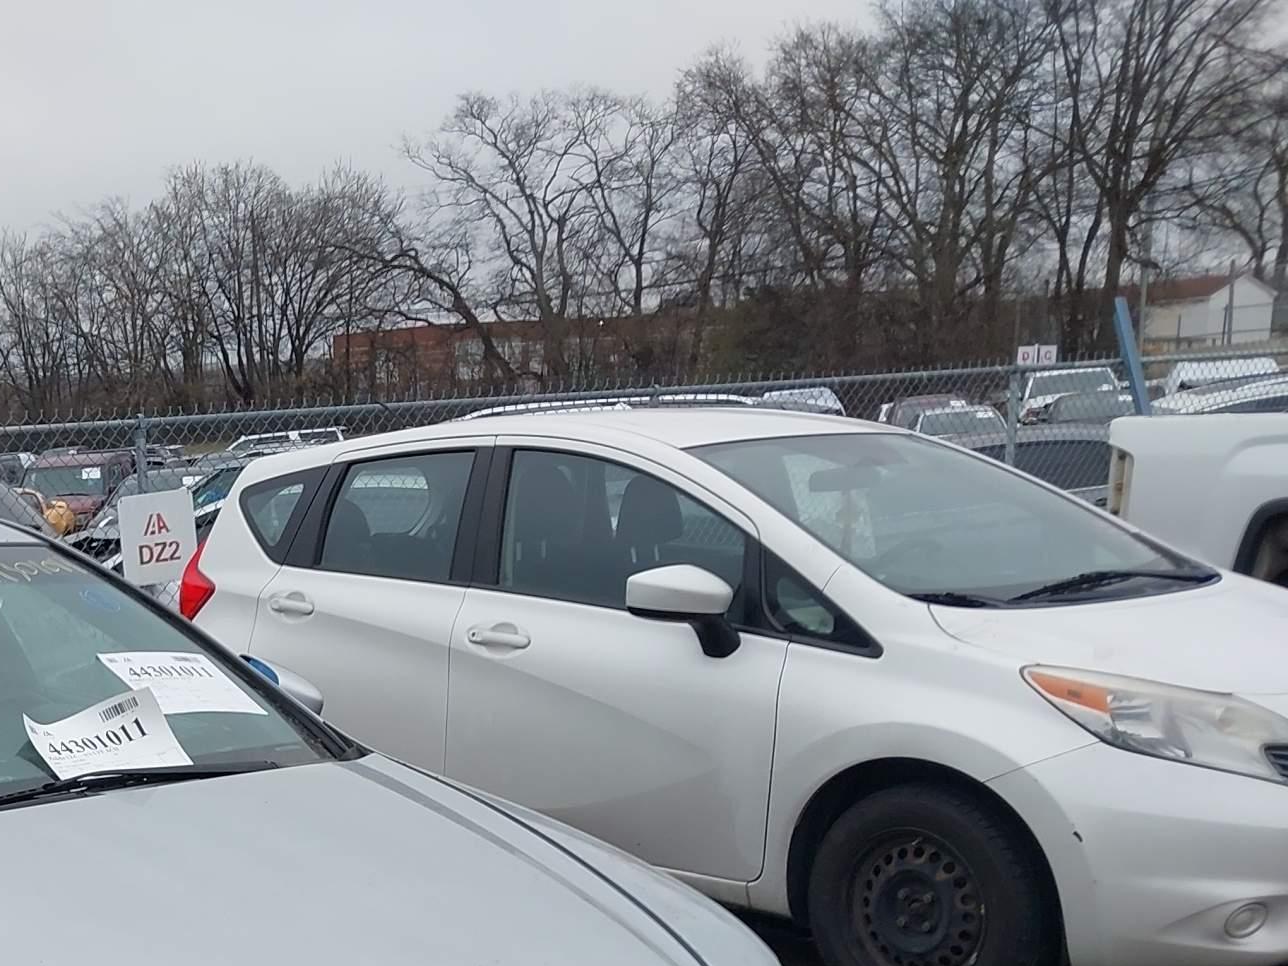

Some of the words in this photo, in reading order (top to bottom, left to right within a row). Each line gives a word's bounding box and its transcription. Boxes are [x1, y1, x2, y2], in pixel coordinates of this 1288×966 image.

[138, 541, 181, 565] DZ2
[128, 664, 214, 678] 44301011
[48, 716, 148, 756] 44301011
